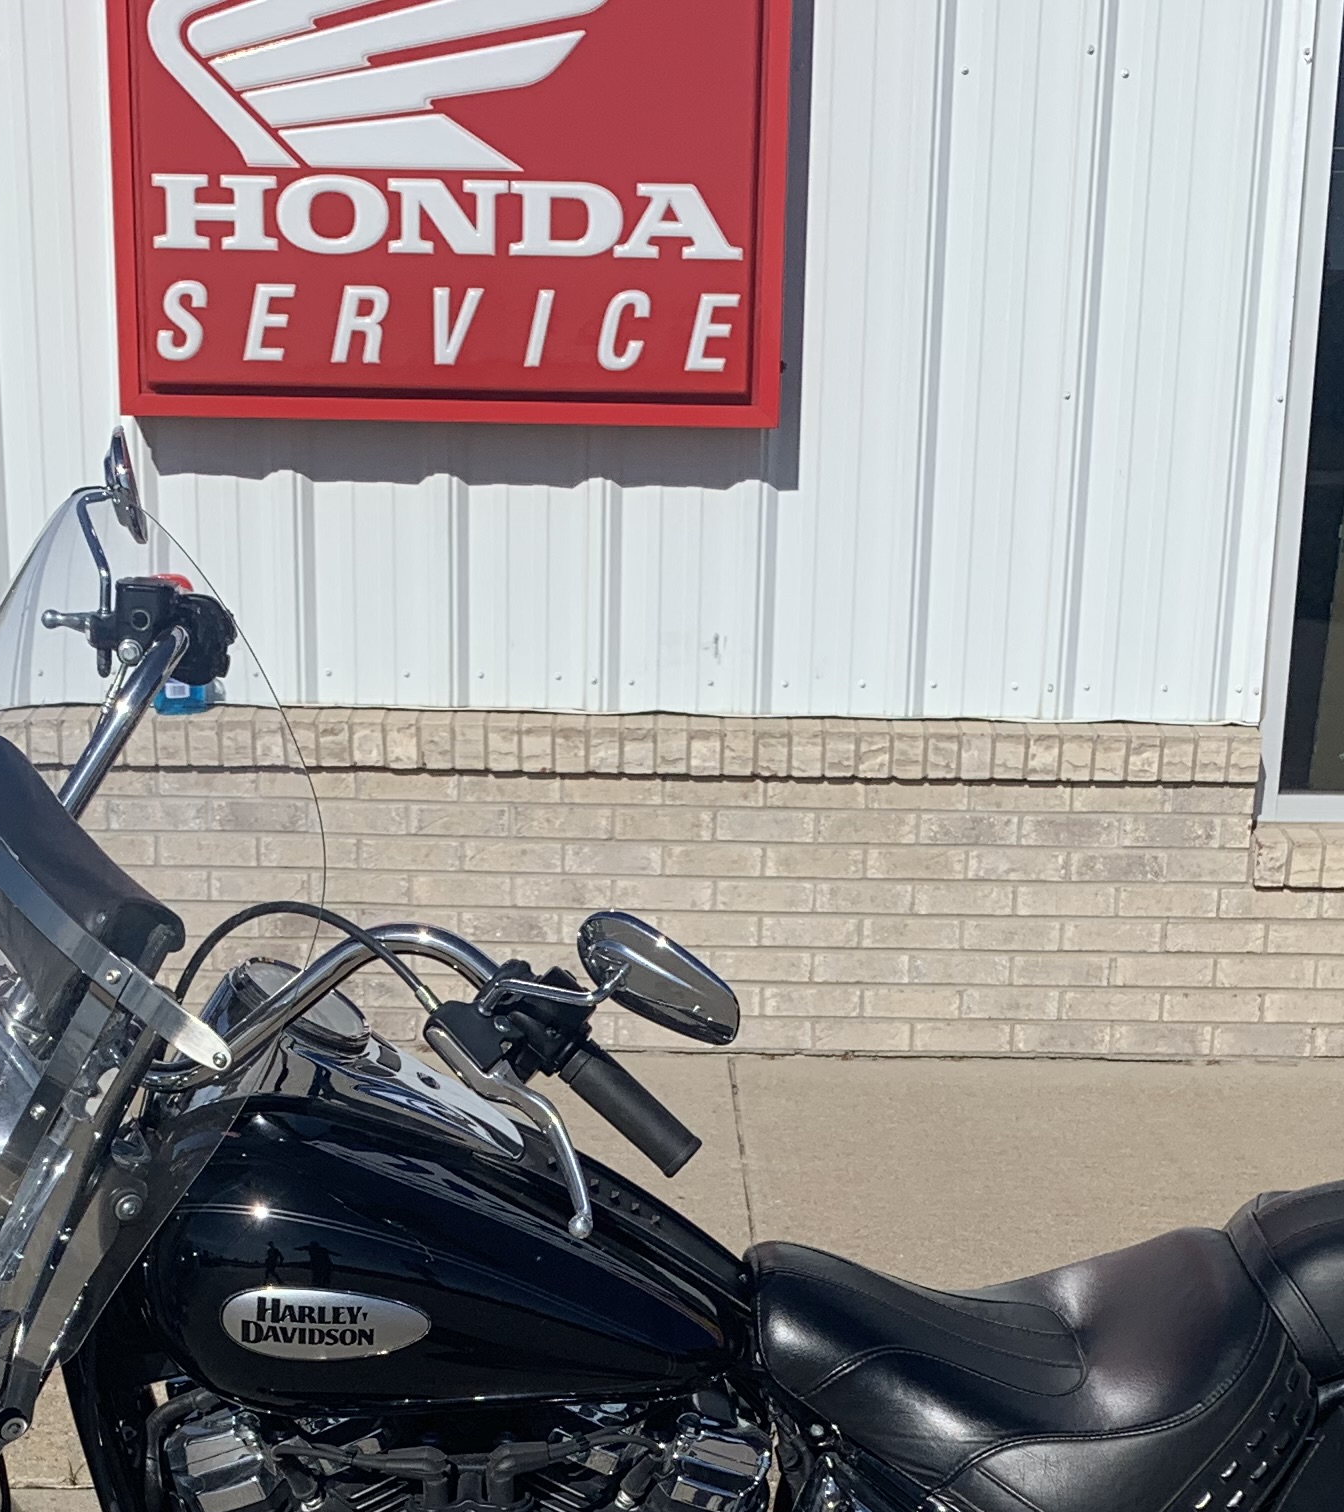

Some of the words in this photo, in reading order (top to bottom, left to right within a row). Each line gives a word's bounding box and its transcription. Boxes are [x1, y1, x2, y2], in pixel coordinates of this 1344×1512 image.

[151, 173, 744, 261] HONDA
[156, 279, 742, 372] SERVICE
[241, 1320, 375, 1346] DAVIDSON
